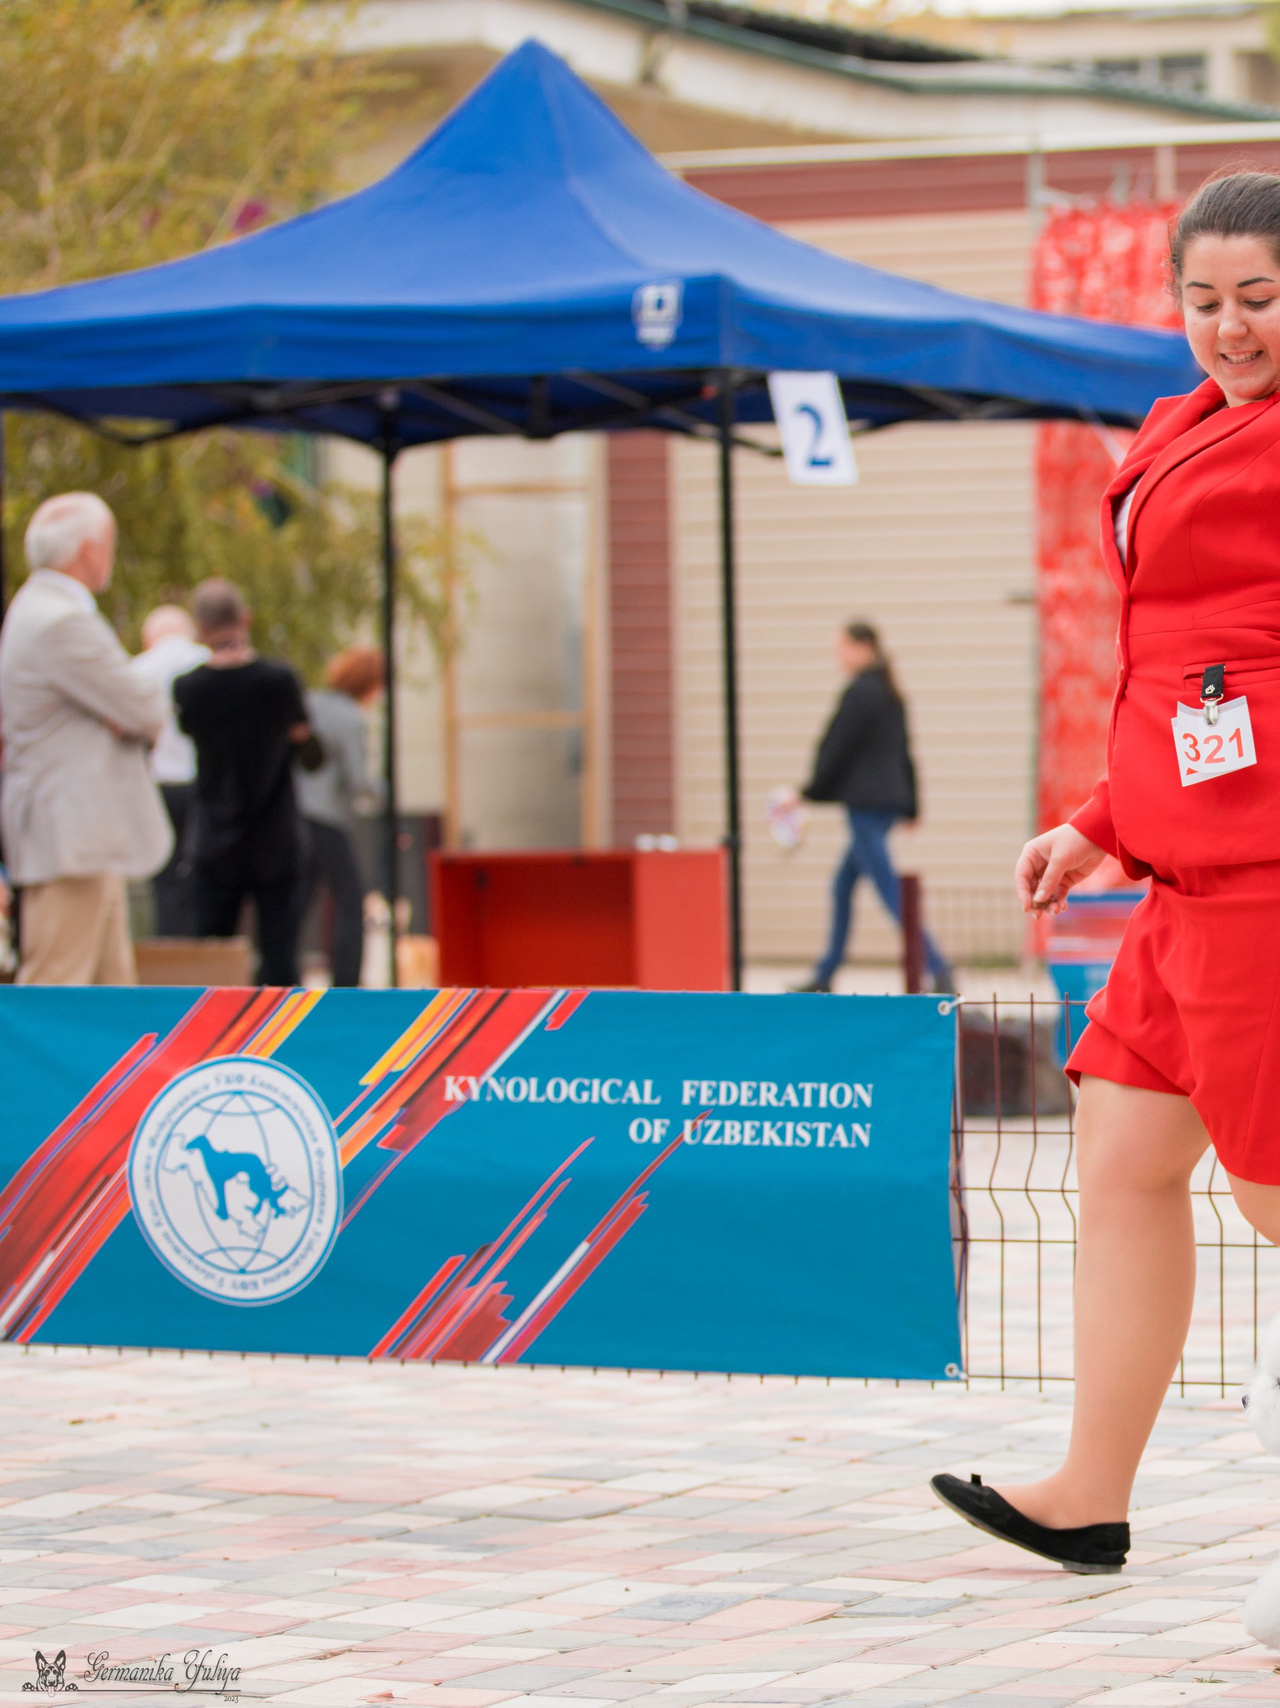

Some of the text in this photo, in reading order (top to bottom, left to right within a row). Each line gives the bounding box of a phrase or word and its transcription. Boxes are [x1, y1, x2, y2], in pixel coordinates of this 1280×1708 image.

[796, 402, 833, 468] 2
[1181, 727, 1245, 764] 321
[444, 1075, 874, 1108] KYNOLOGICAL FEDERATION
[628, 1117, 872, 1148] OF UZBEKISTAN
